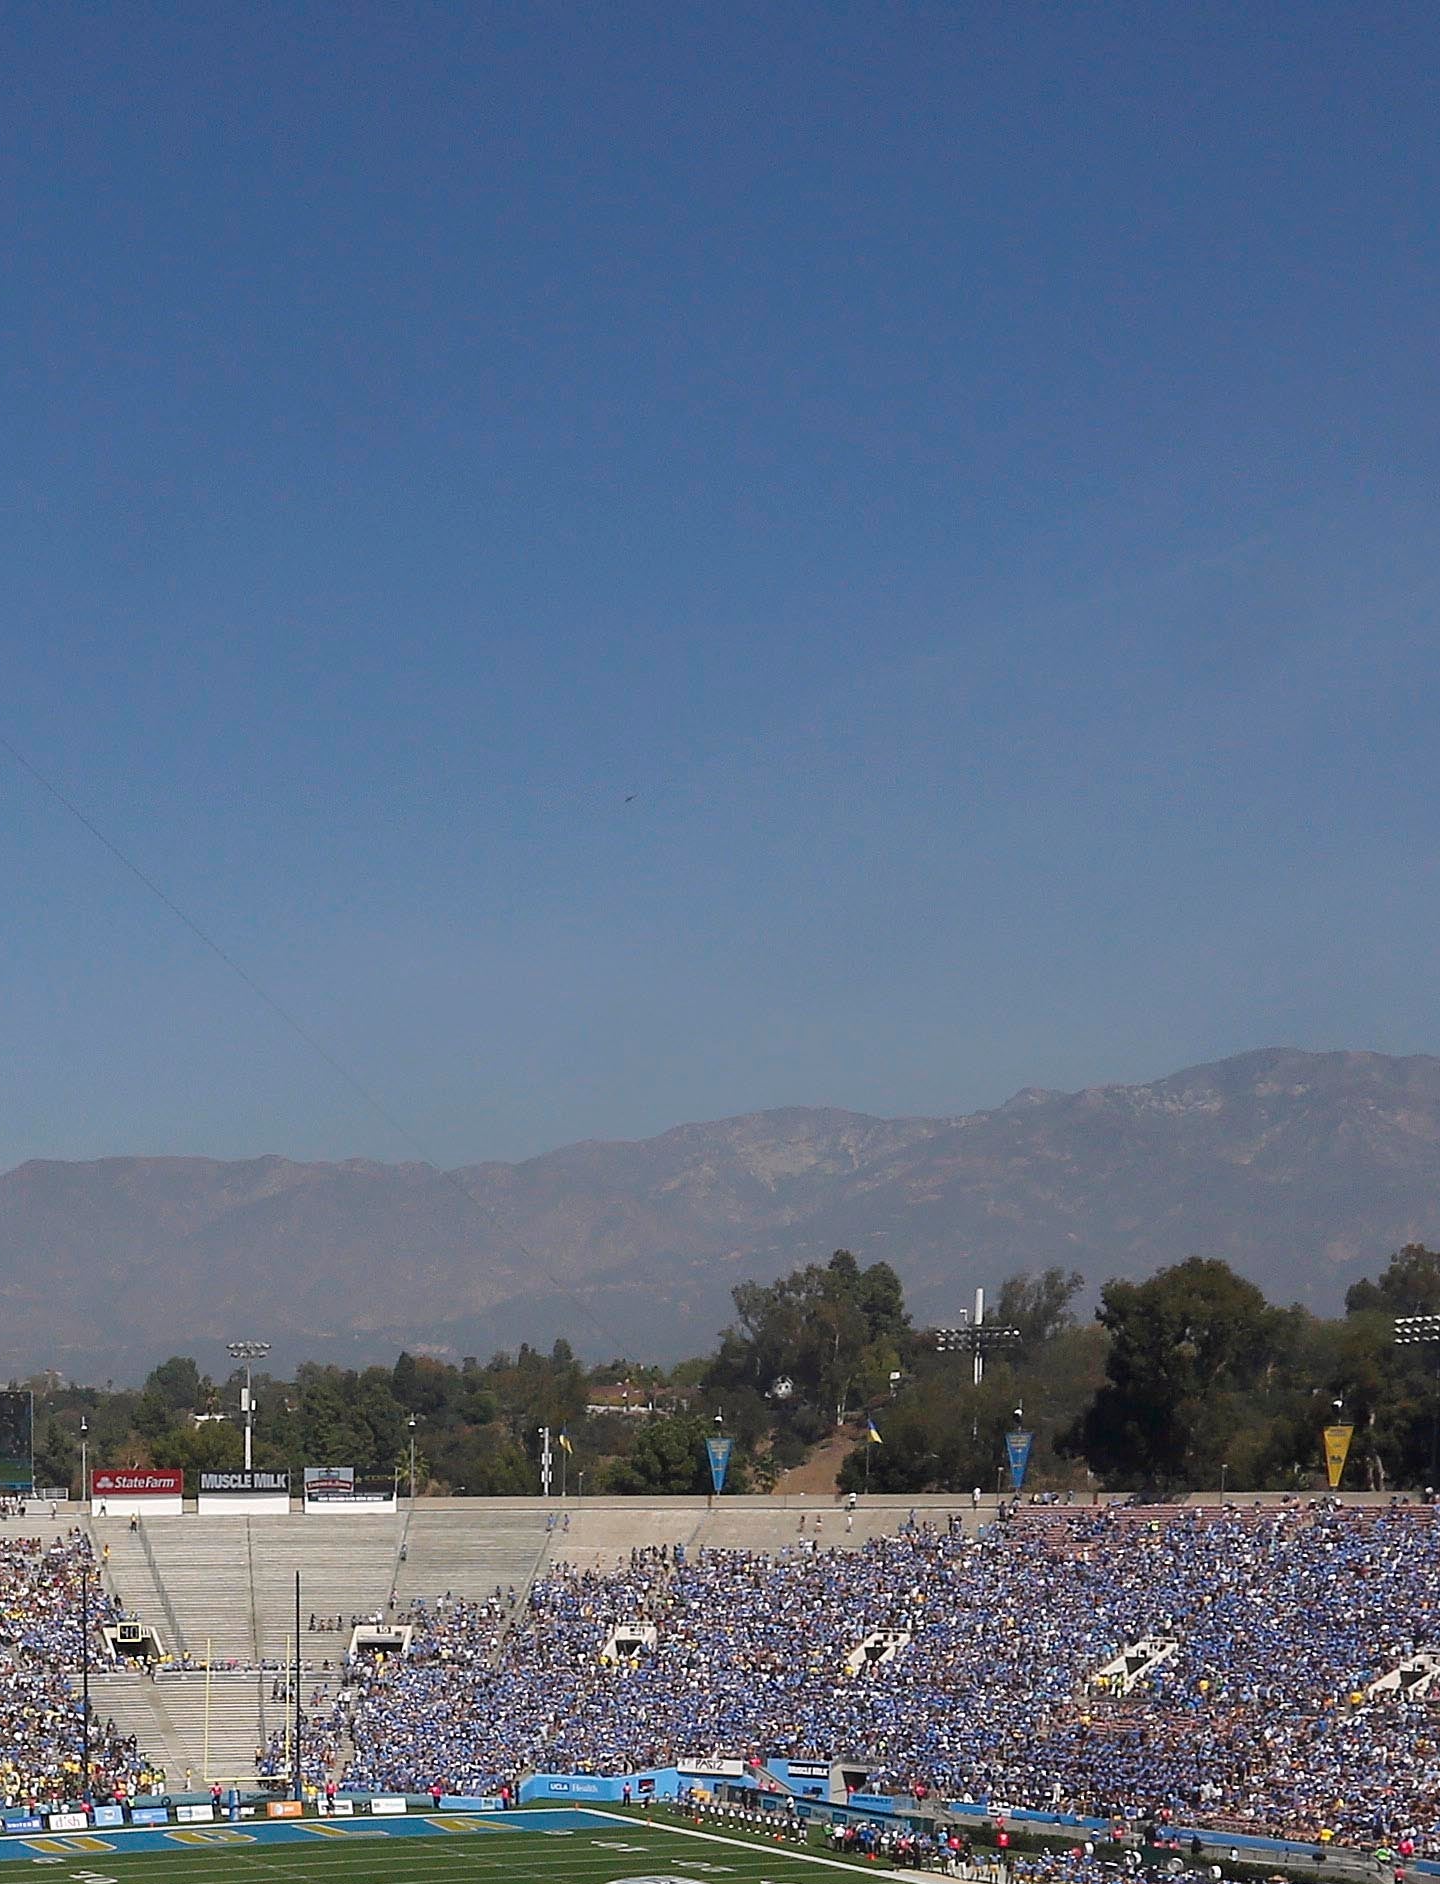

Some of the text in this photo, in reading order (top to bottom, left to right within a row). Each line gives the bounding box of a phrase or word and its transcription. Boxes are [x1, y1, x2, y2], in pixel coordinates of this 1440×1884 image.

[201, 1473, 252, 1490] MUSCLE
[254, 1472, 287, 1489] MILK
[550, 1782, 599, 1793] UCLA Health
[56, 1815, 80, 1829] dish
